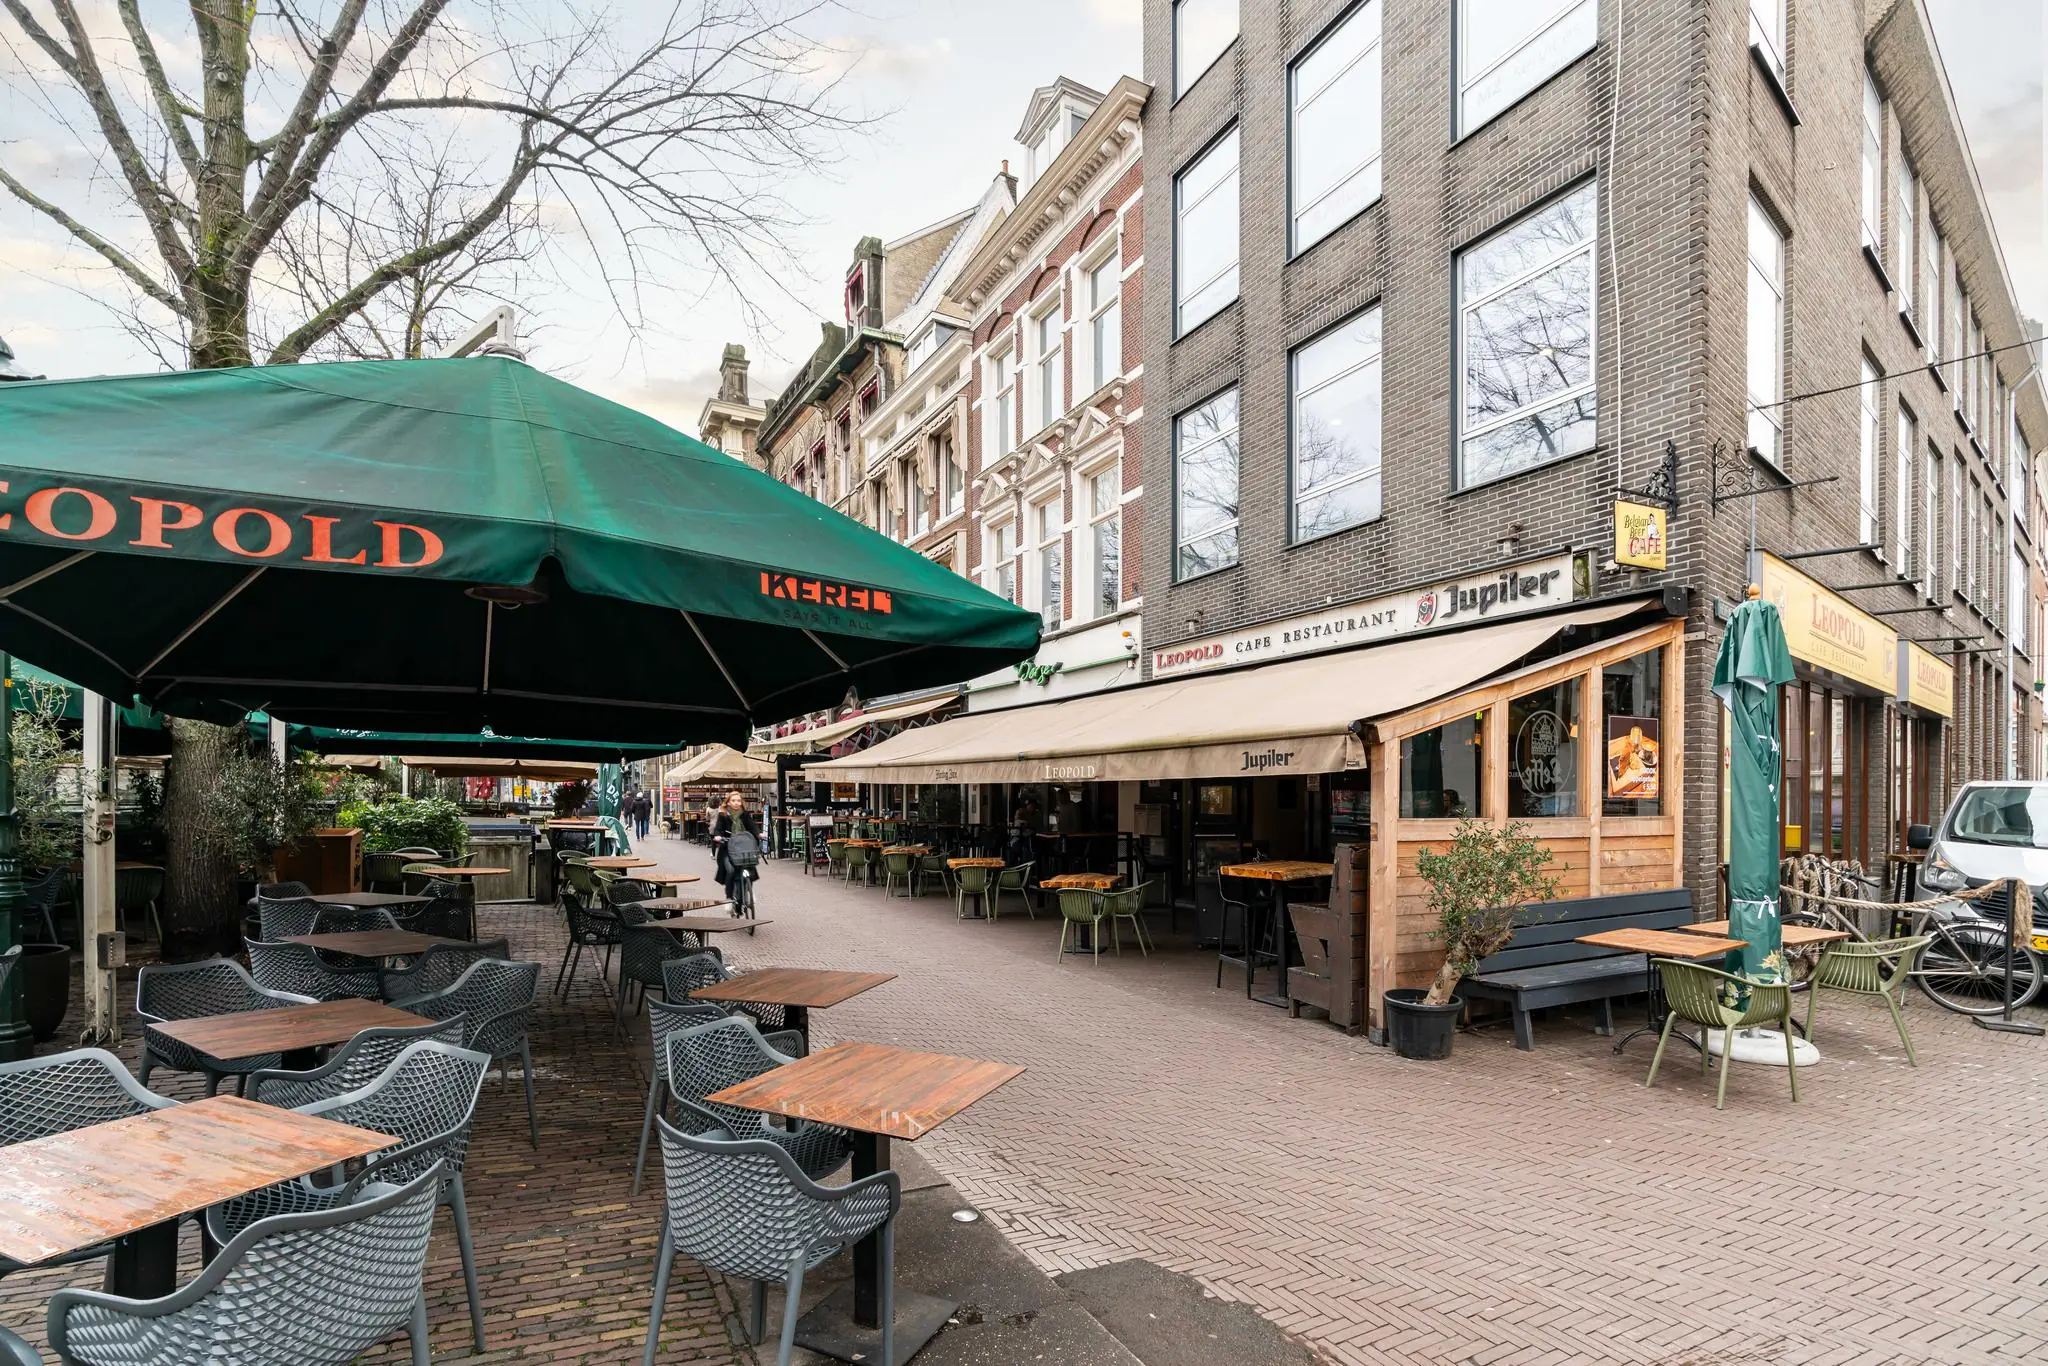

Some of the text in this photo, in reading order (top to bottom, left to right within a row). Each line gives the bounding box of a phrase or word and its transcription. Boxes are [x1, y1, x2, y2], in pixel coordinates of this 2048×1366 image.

[0, 481, 444, 568] OPOLD
[760, 571, 893, 615] KEREL
[783, 608, 874, 631] SAYS IT ALL
[1236, 636, 1272, 653] CAFE
[1283, 609, 1397, 644] RESTAURANT
[1440, 569, 1561, 618] Jupiler
[1045, 765, 1095, 779] LEOPOLD
[1240, 749, 1295, 771] Jupiler
